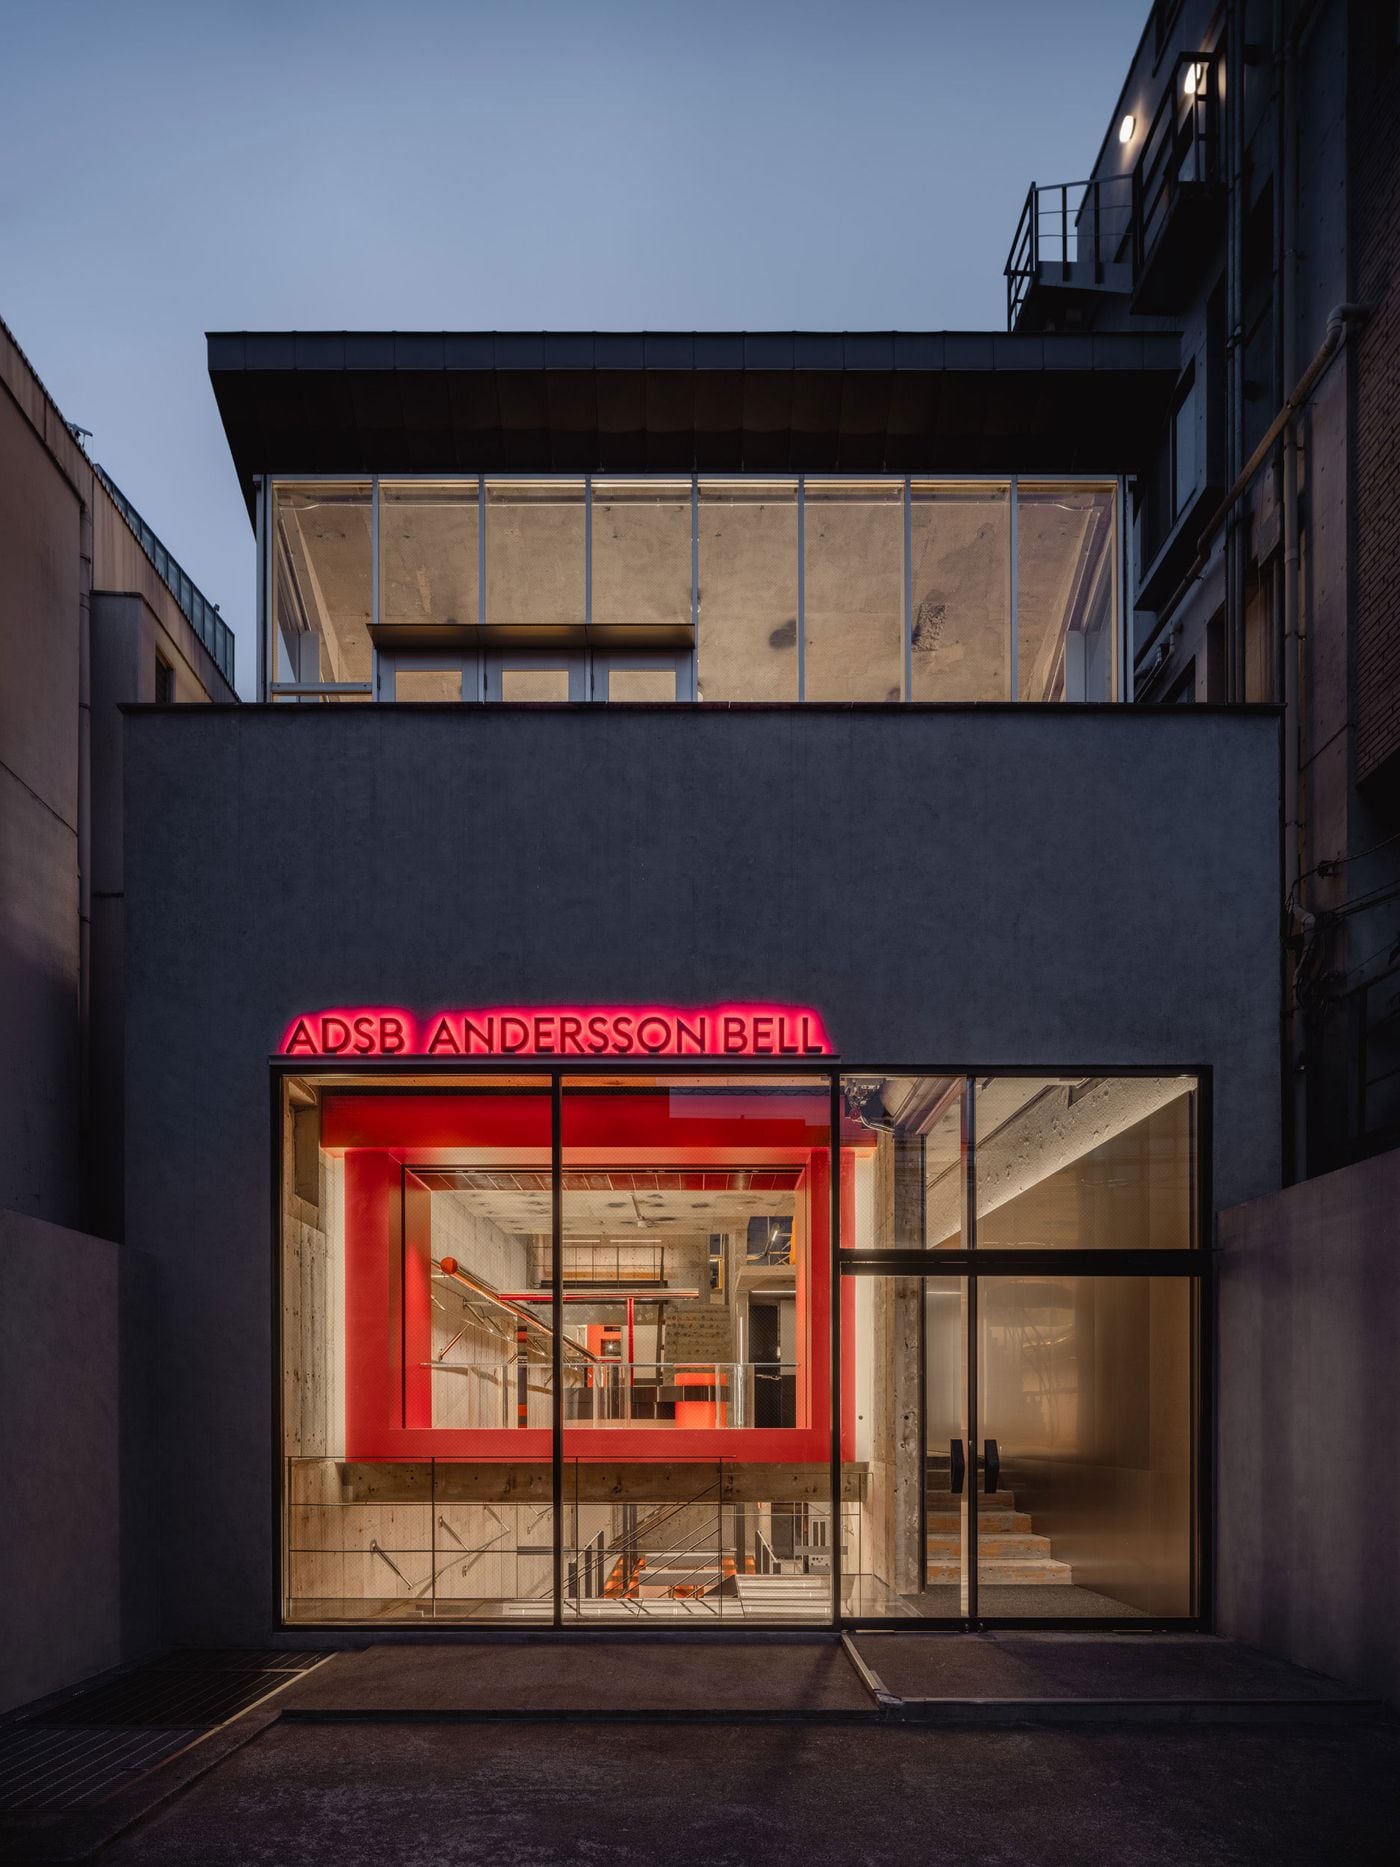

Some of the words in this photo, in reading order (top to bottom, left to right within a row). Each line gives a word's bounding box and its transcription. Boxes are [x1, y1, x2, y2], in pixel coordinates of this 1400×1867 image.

[286, 1017, 406, 1054] ADSB
[427, 1017, 707, 1054] ANDERSSON
[723, 1017, 823, 1054] BELL
